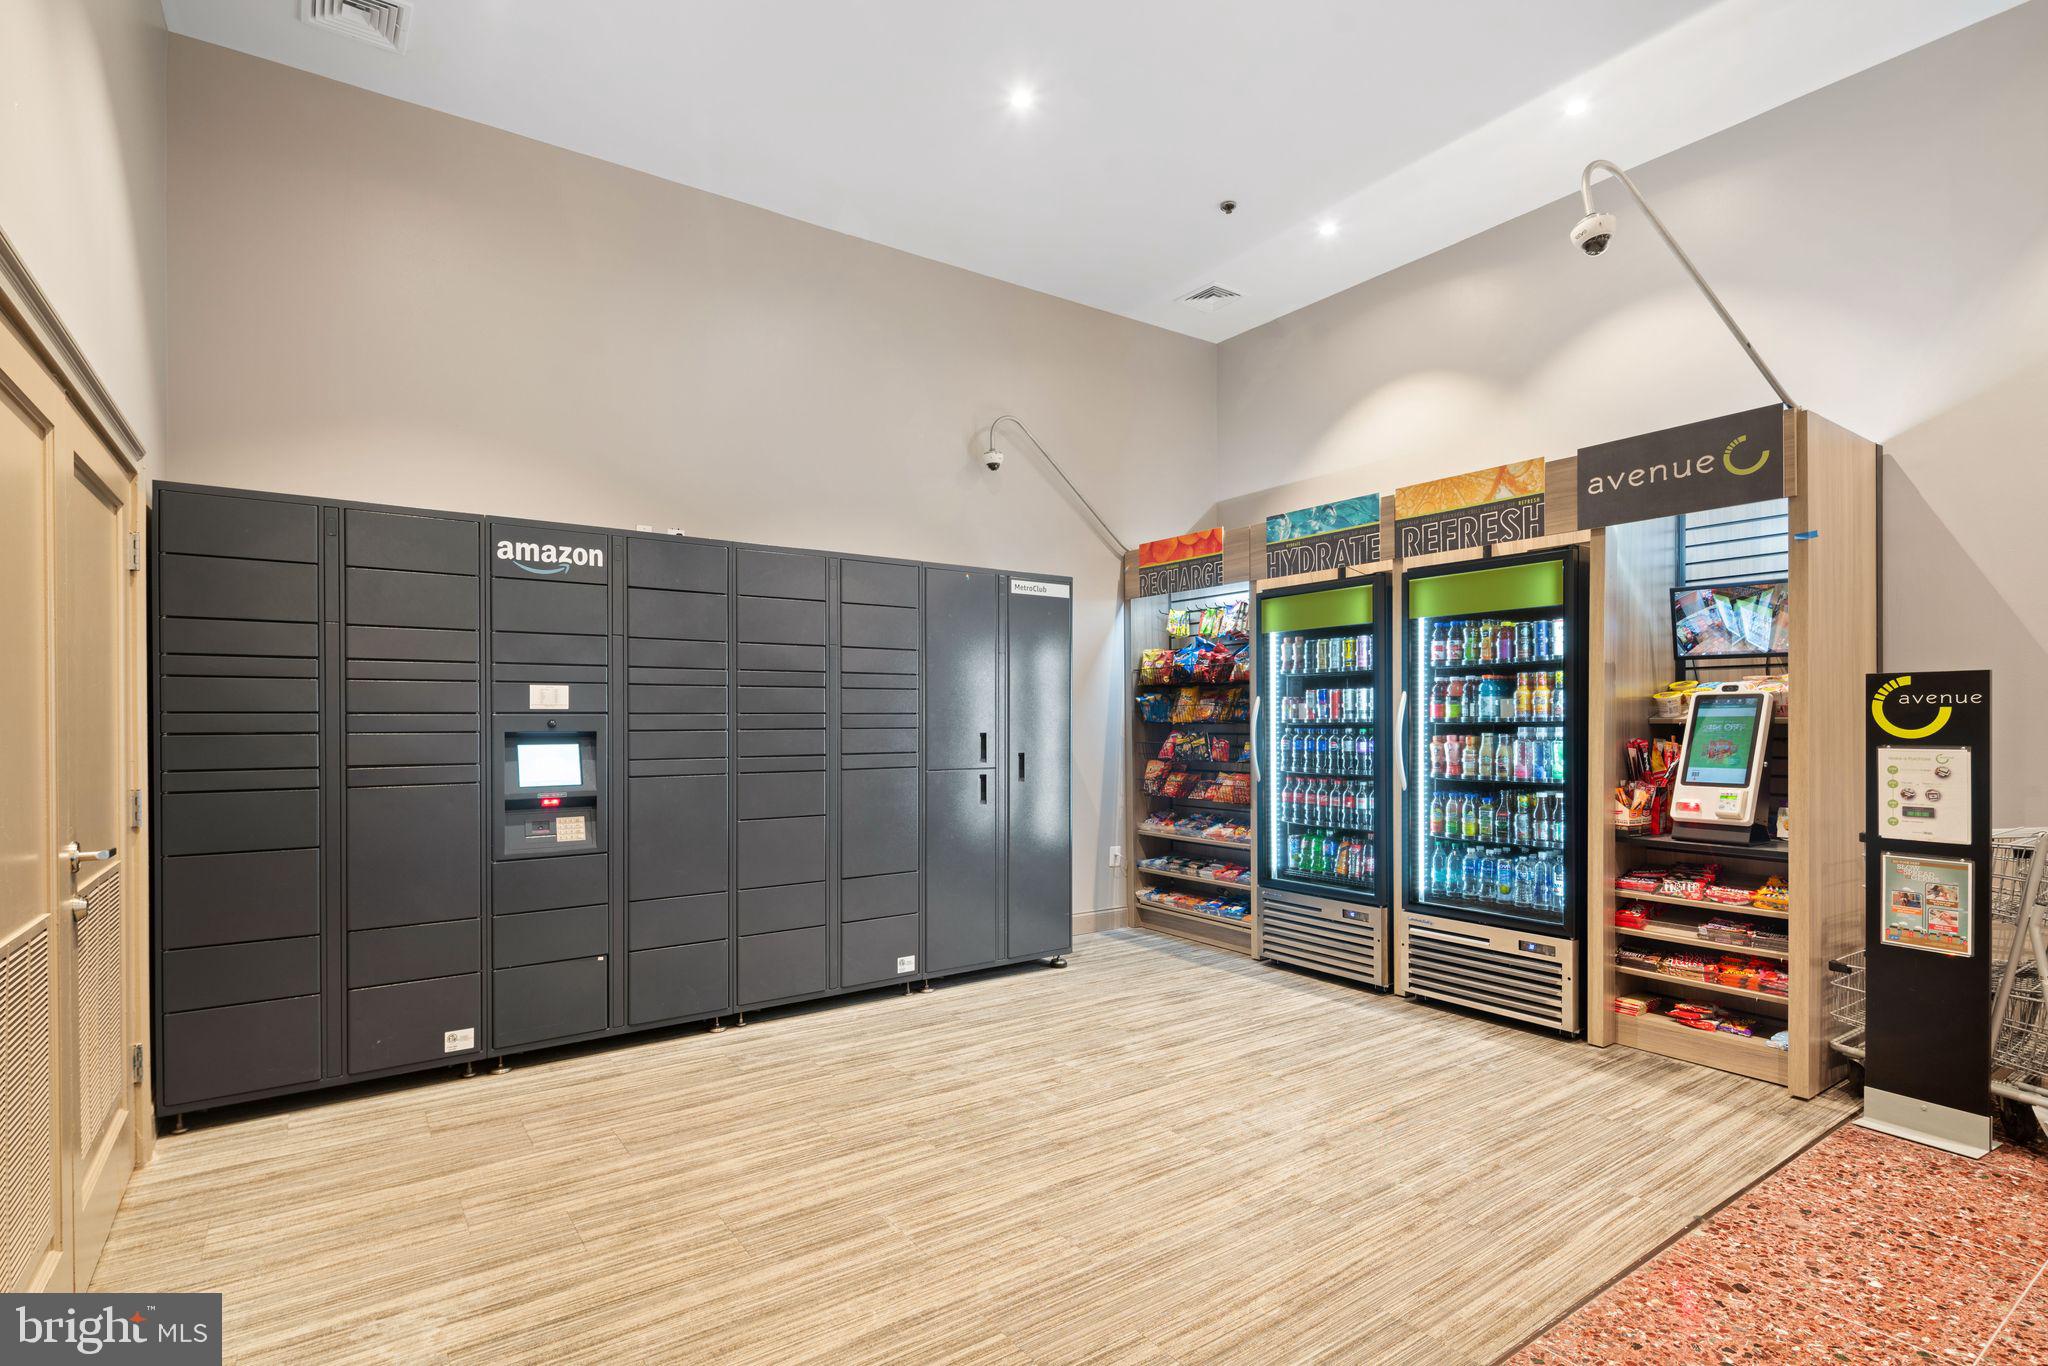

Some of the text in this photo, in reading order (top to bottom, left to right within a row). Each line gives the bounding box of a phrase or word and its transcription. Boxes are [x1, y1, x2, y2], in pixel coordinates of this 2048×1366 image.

[1587, 453, 1715, 496] avenue
[1402, 503, 1545, 557] REFRESH
[496, 540, 604, 567] amazon
[1266, 532, 1380, 578] HYDRATE
[1014, 583, 1047, 593] MetroClub
[1139, 561, 1224, 597] RECHARGE
[1898, 693, 1983, 705] avenue
